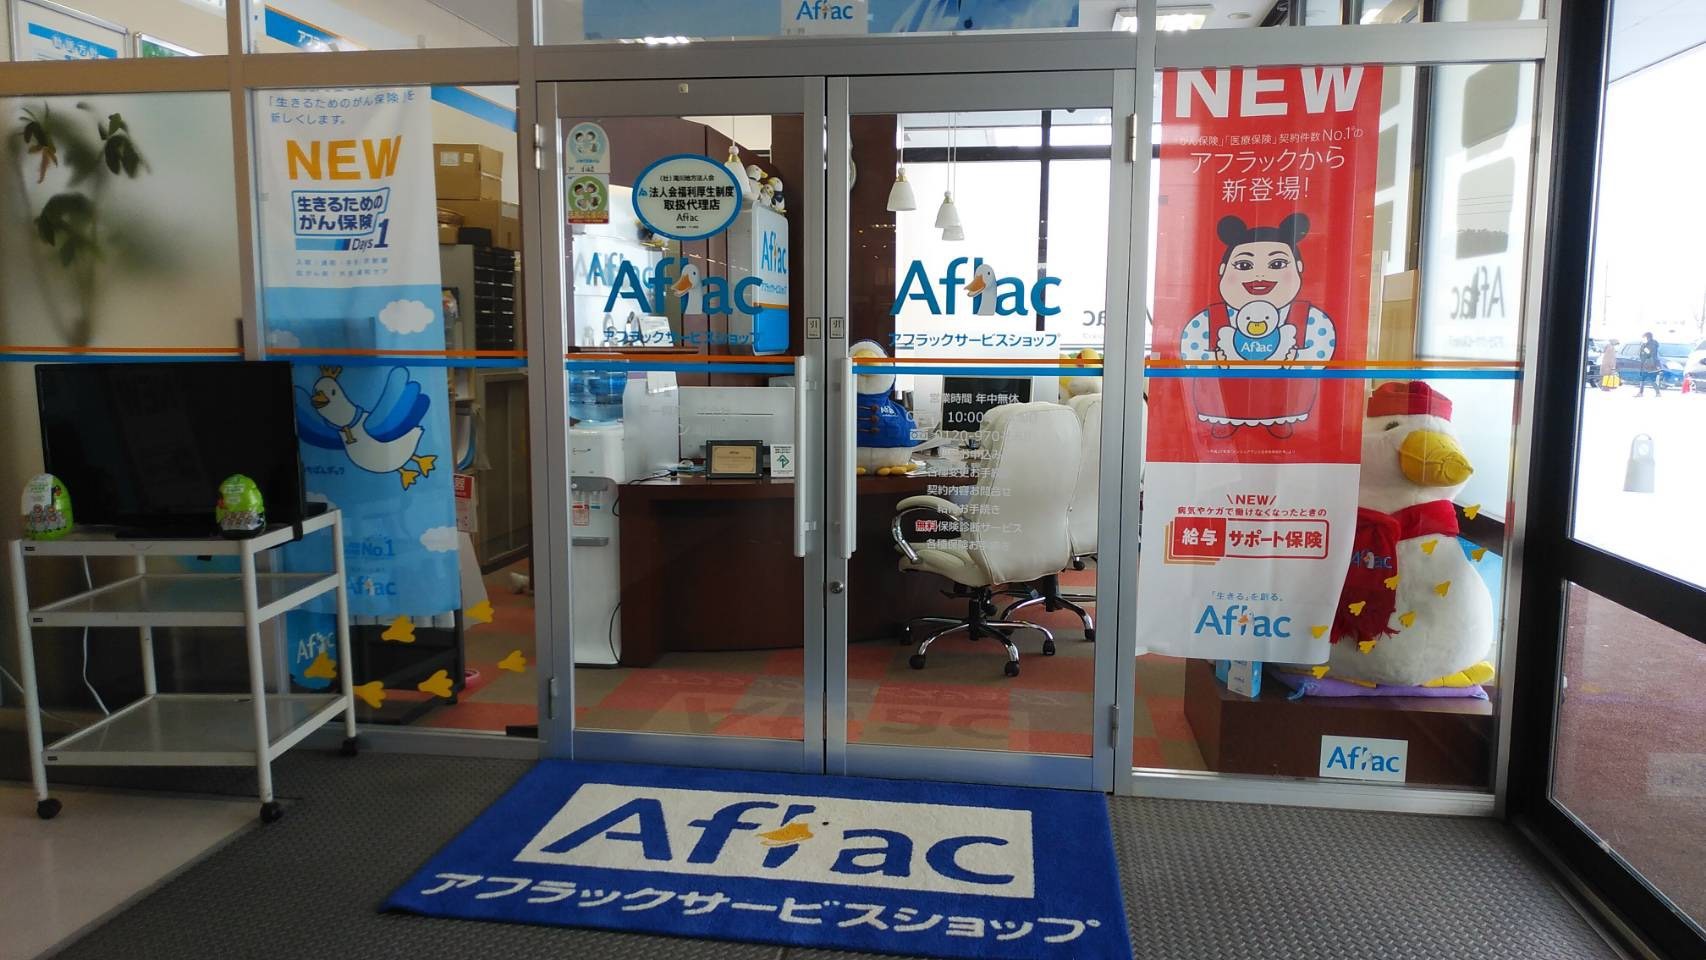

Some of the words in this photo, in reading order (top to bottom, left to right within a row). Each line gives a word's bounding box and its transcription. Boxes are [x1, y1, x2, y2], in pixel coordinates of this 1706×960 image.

[796, 0, 853, 20] Aflac
[1176, 67, 1364, 118] NEW
[286, 134, 402, 180] NEW
[1191, 146, 1345, 174] アフラックから
[649, 186, 734, 198] 法人会福利厚生制度
[297, 195, 384, 213] 生きるための
[664, 199, 720, 211] 取扱代理店
[299, 213, 374, 231] がん保険
[676, 213, 699, 222] Aflac
[604, 256, 763, 315] Aflac
[890, 257, 1062, 316] Aflac
[604, 330, 761, 345] アフラックサービスショップ
[889, 332, 1061, 348] アフラックサービスショップ
[1240, 341, 1273, 352] Aflac
[1177, 507, 1327, 517] 病気やケガで働けなくなったときの
[1181, 528, 1218, 546] 給与
[1229, 530, 1323, 549] サポート保険
[1194, 605, 1291, 638] Aflac
[1327, 746, 1399, 772] Aflac
[539, 797, 1015, 885] Aflac
[420, 872, 1101, 943] アフラックサービスショップ
